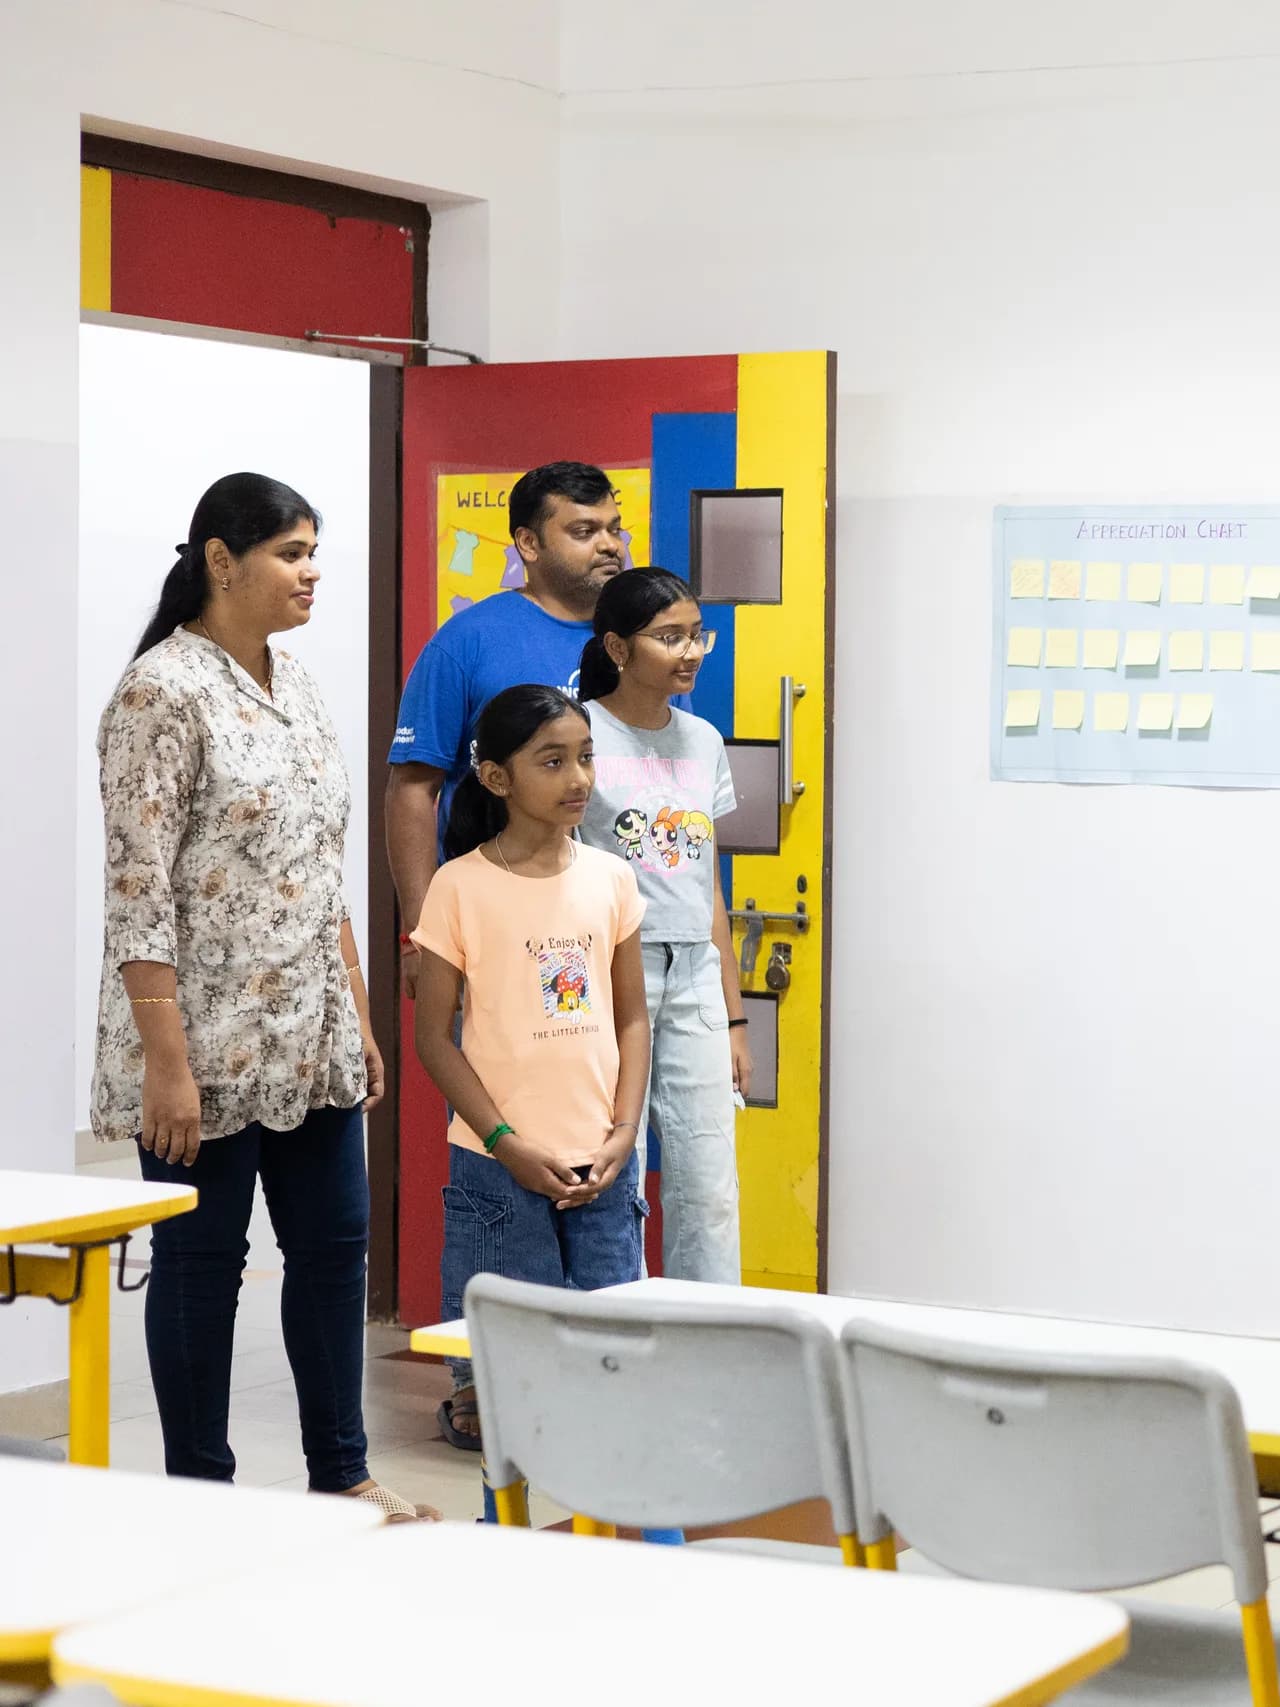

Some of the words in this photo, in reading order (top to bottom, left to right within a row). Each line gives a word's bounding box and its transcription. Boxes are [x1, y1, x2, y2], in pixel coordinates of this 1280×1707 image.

[457, 490, 506, 508] WELC
[548, 937, 576, 950] Enjoy
[532, 1030, 549, 1040] THE
[551, 1026, 579, 1038] LITTLE
